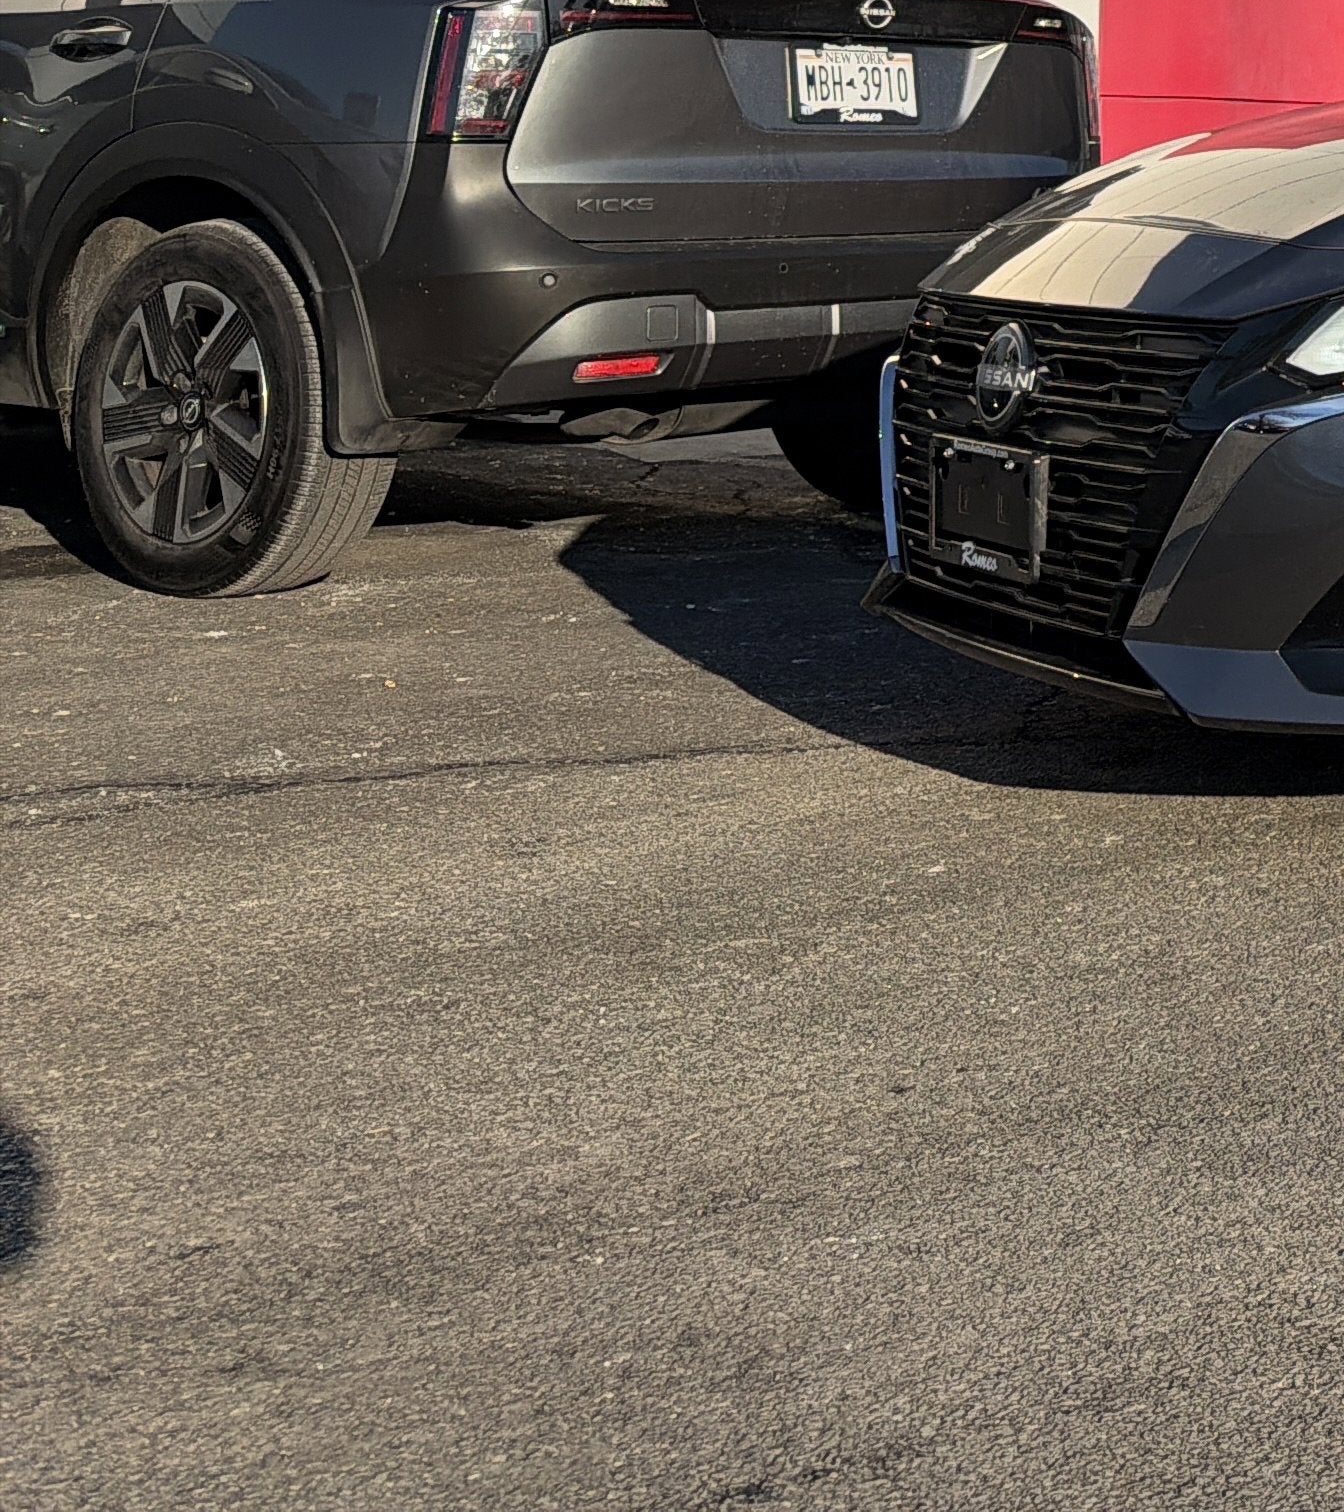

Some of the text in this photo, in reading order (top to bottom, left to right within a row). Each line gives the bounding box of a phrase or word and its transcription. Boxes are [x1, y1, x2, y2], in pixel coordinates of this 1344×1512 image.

[825, 52, 885, 65] NEW YORK
[839, 106, 883, 122] Romeo
[576, 197, 654, 212] KICKS
